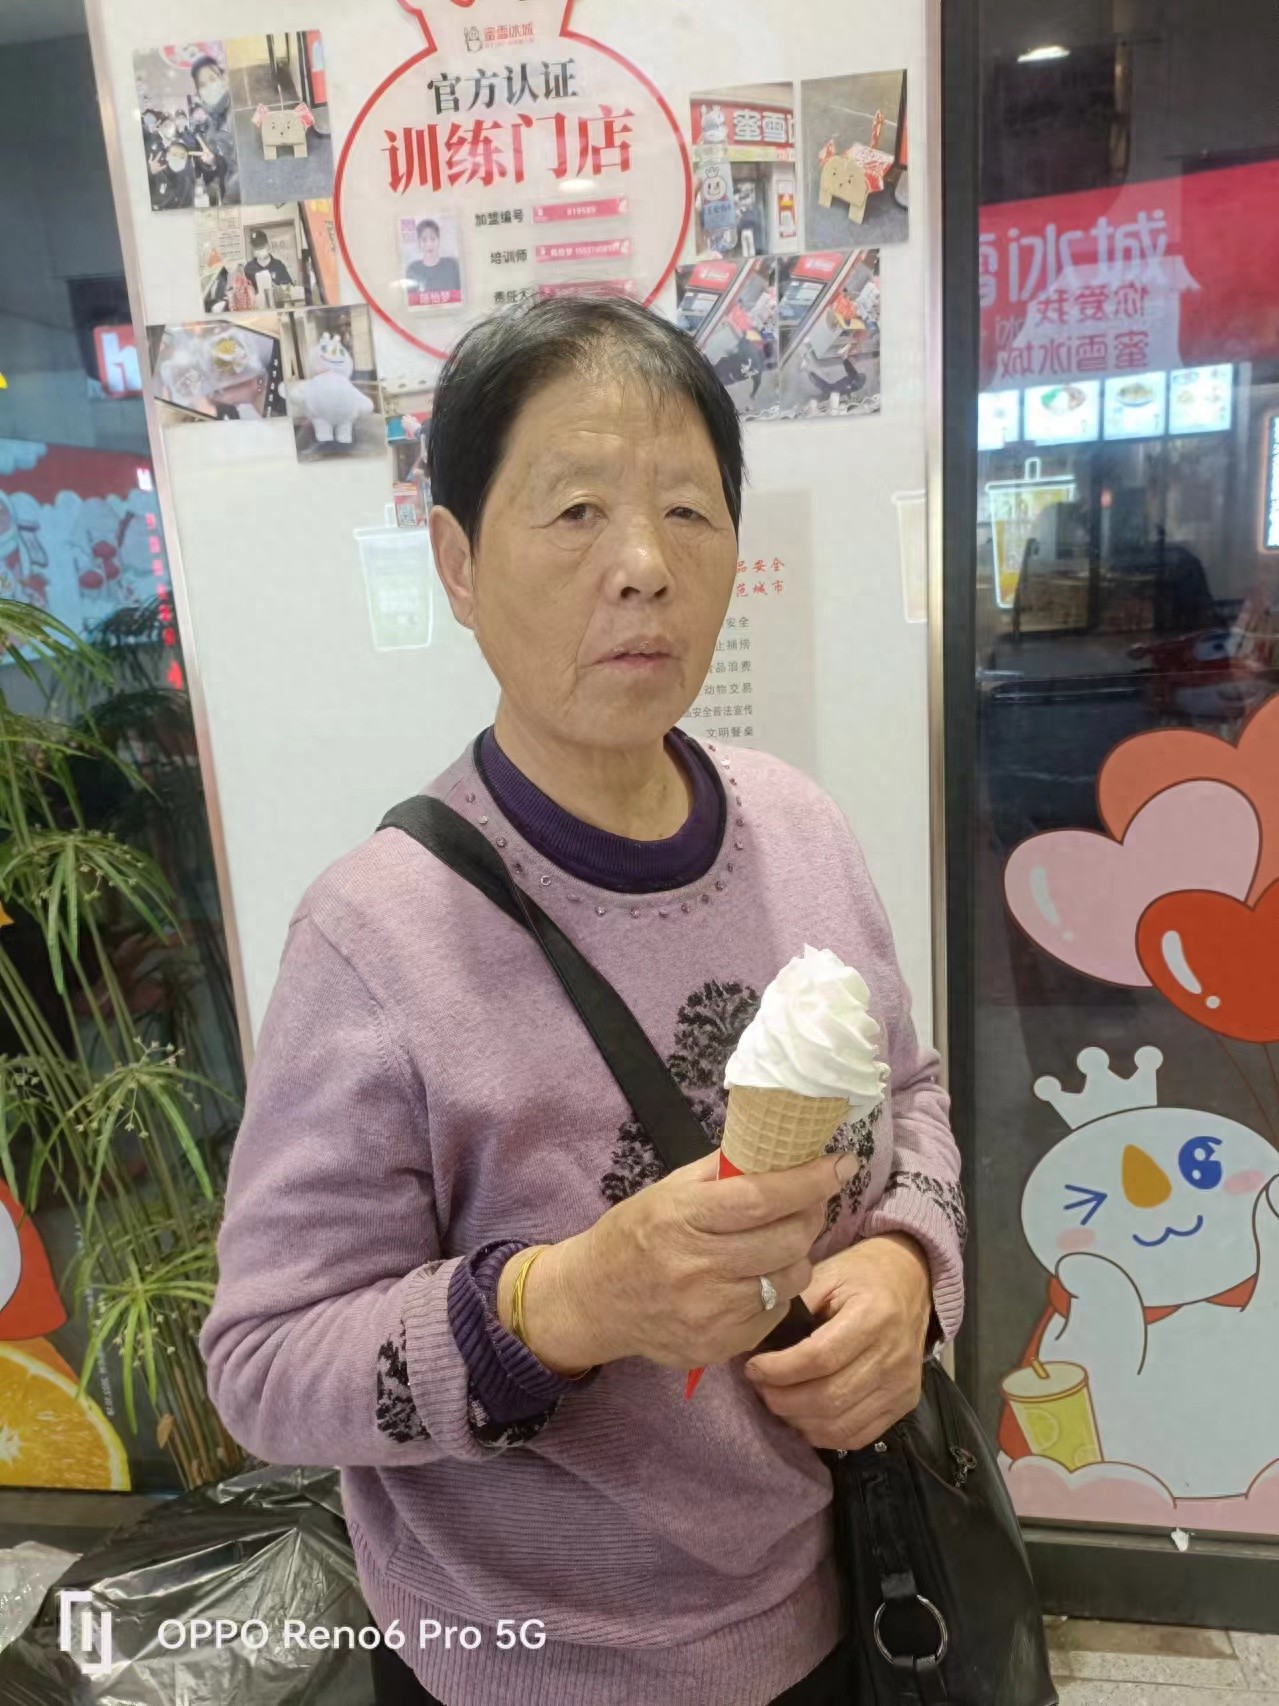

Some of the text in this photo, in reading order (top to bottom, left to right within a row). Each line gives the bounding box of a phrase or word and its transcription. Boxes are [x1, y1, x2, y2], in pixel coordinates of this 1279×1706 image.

[427, 58, 578, 115] 官方认证
[381, 104, 635, 194] 训练门店
[475, 209, 524, 226] 加盟编号
[490, 249, 528, 264] 培训师
[699, 682, 752, 696] 动物交易
[706, 727, 754, 739] 文明餐桌
